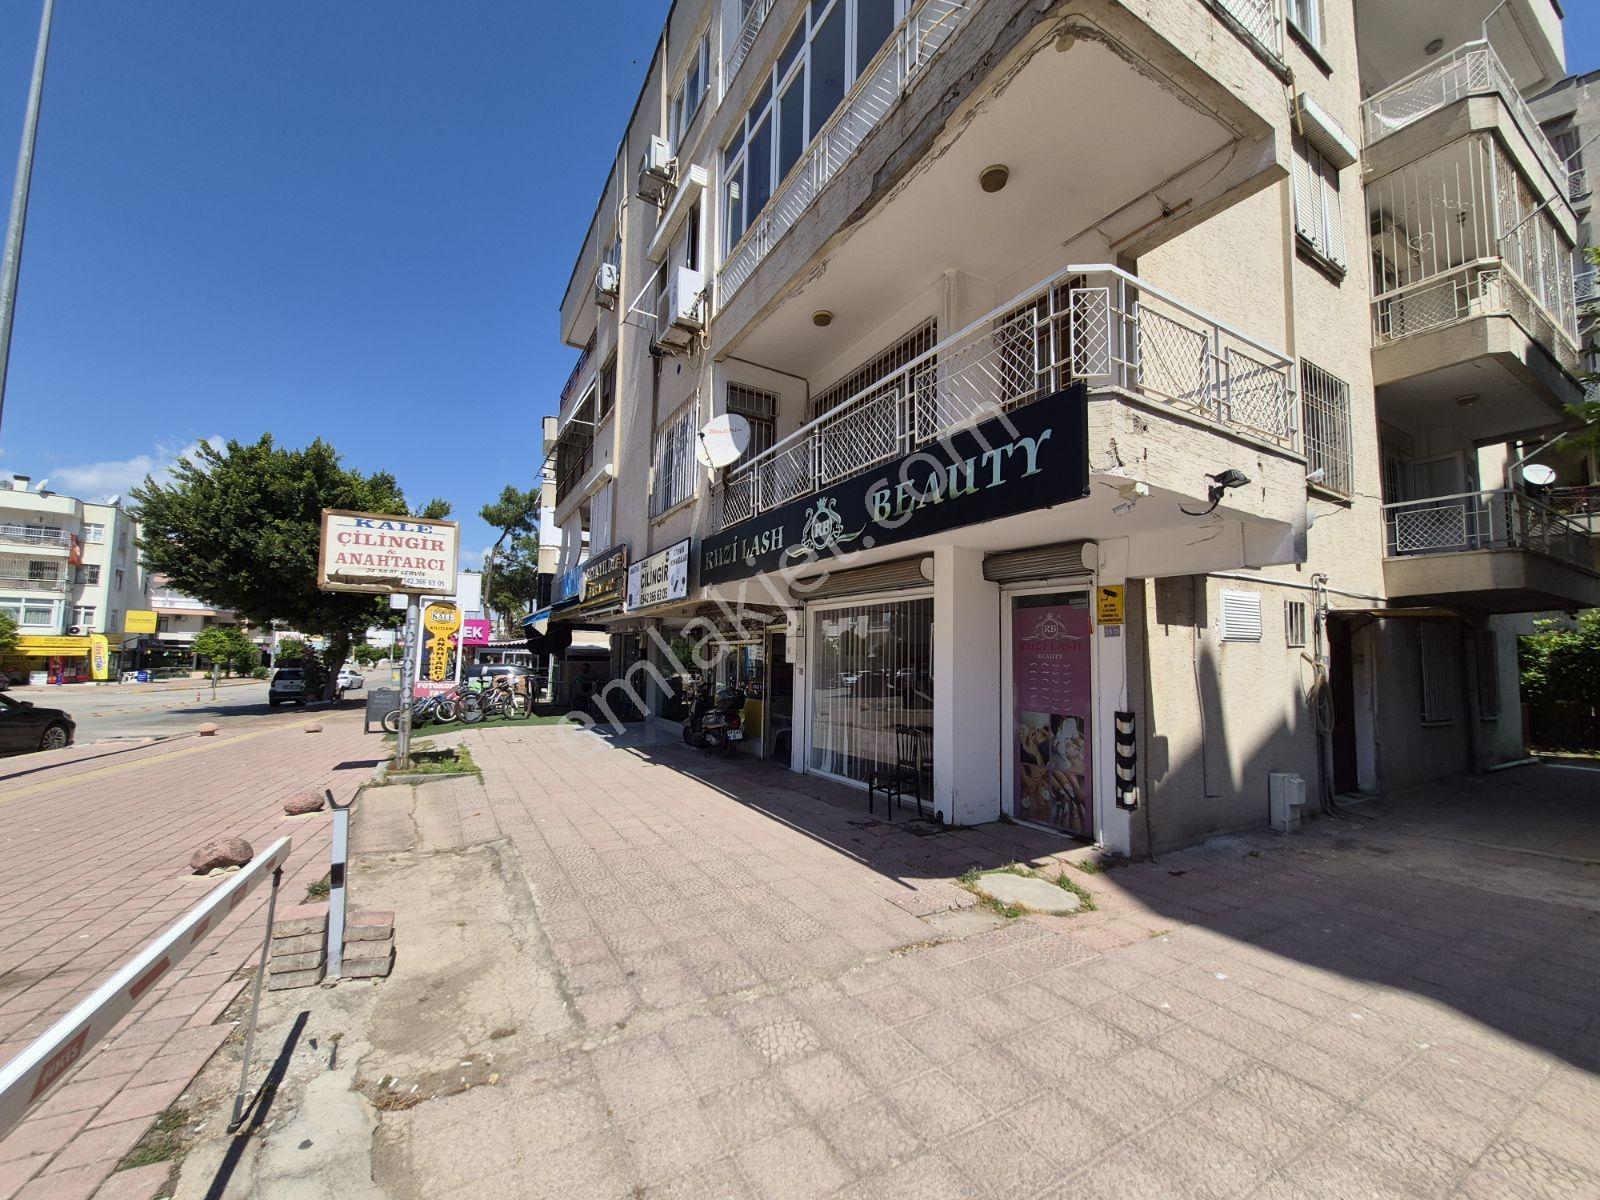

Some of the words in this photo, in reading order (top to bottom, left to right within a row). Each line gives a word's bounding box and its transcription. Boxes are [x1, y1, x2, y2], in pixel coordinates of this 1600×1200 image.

[704, 534, 738, 571] RUZİ
[741, 525, 783, 567] LASH
[872, 428, 1053, 523] BEAUTY
[354, 518, 434, 534] KALE
[337, 530, 446, 552] ÇİLİNGİR
[335, 552, 446, 571] ANAHTARCI
[641, 561, 668, 593] ÇİLİNGİR
[432, 611, 454, 621] KALE
[1044, 625, 1057, 633] RB
